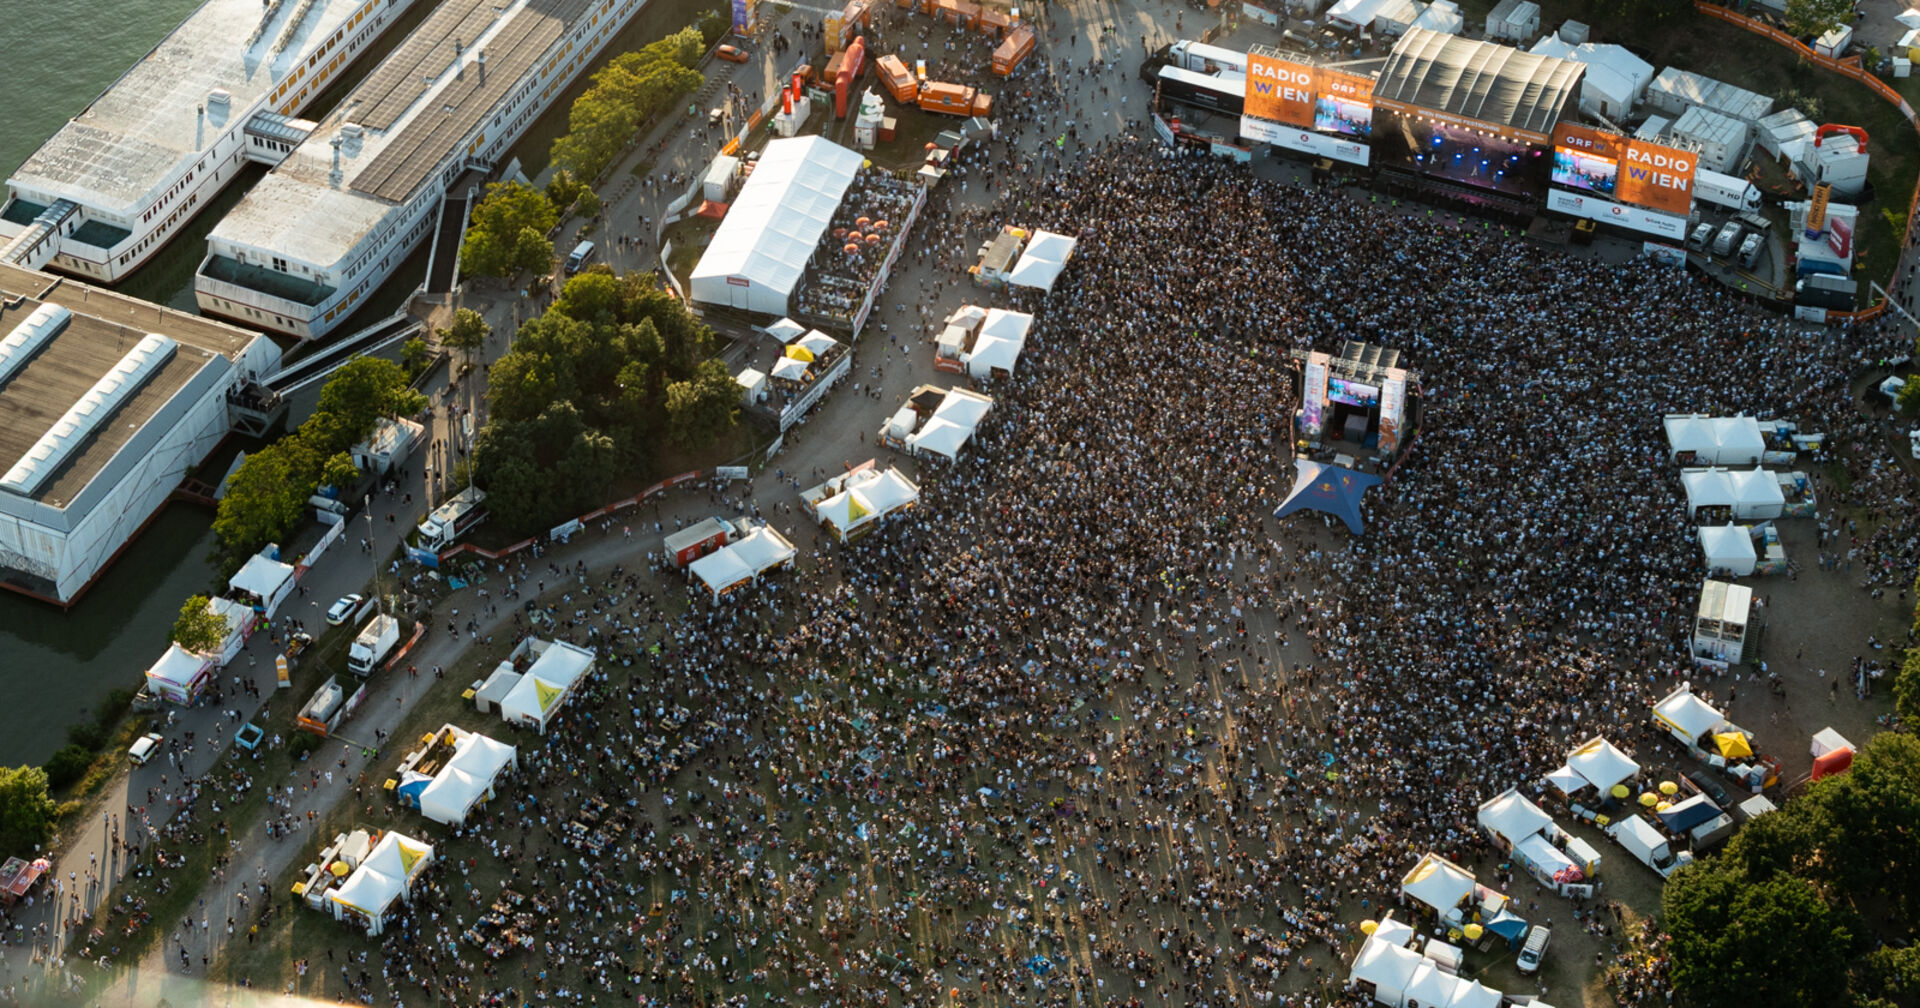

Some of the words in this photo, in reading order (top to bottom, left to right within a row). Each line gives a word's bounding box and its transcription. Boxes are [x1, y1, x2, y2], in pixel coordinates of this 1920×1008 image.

[1252, 63, 1310, 85] RADIO
[1331, 82, 1356, 94] ORF
[1566, 136, 1592, 148] ORF
[1626, 148, 1689, 172] RADIO
